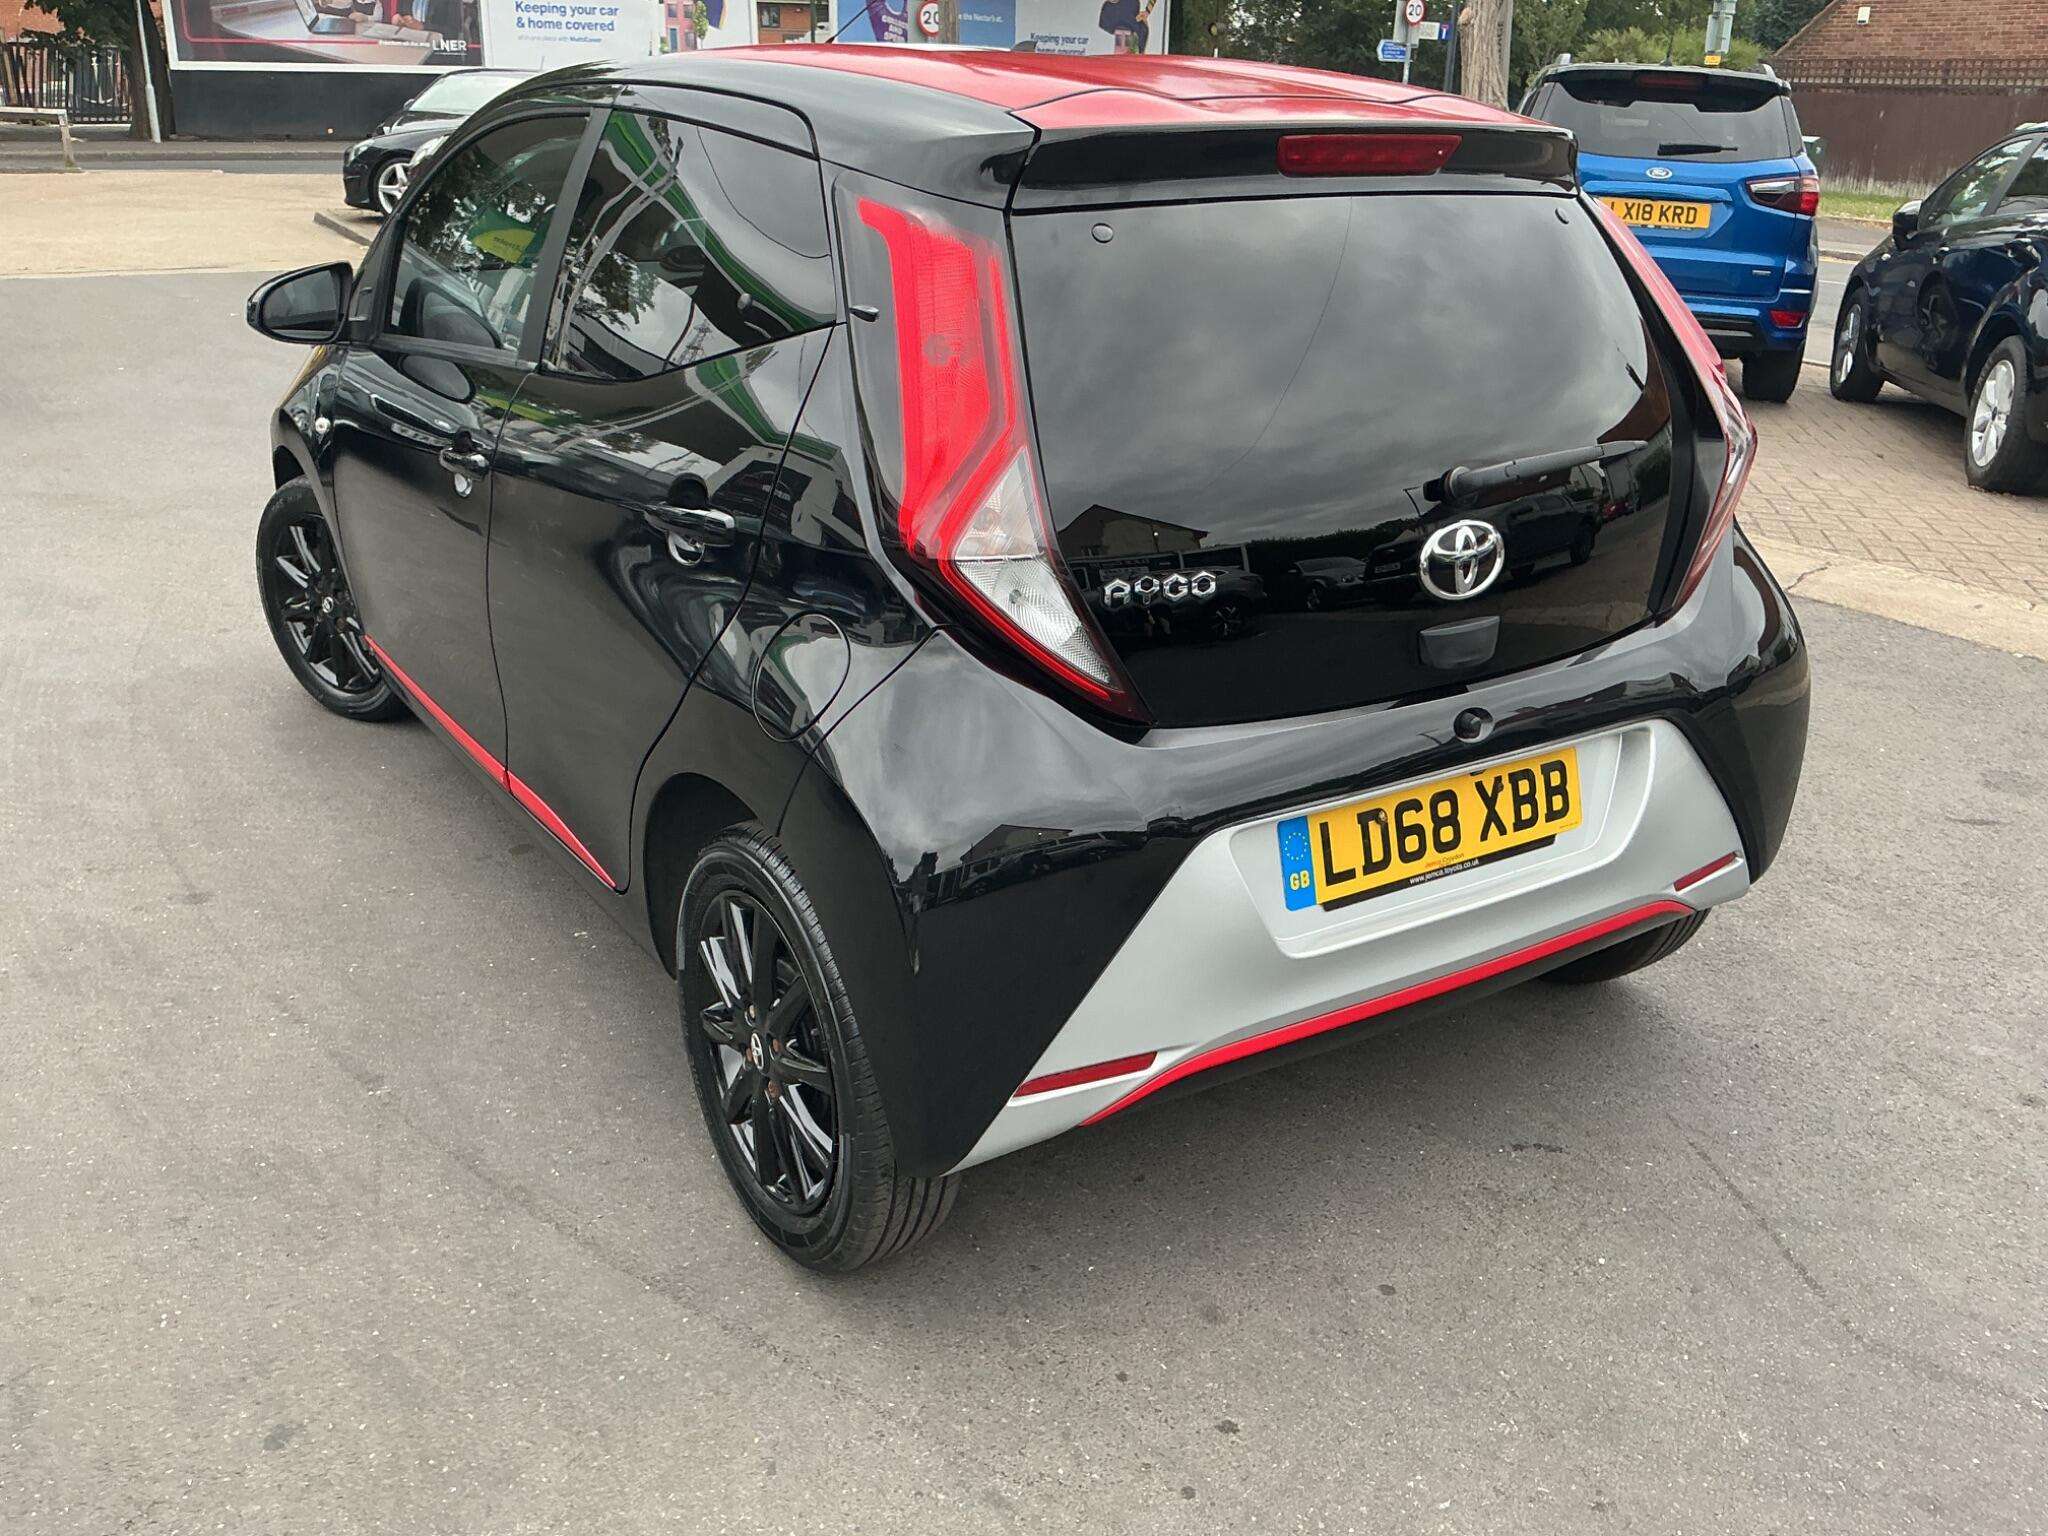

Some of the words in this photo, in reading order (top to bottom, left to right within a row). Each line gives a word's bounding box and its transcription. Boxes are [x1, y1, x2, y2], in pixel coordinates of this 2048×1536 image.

[515, 1, 567, 17] Keeping
[570, 6, 598, 17] your
[600, 8, 619, 16] car
[1408, 4, 1421, 16] 20
[516, 16, 525, 28] &
[528, 18, 562, 29] home
[565, 20, 615, 31] covered
[432, 38, 467, 52] LNER
[1031, 32, 1060, 46] Keeping
[1061, 36, 1077, 46] your
[1658, 204, 1698, 225] KRD
[1104, 571, 1216, 605] AYGO
[1319, 789, 1461, 887] LD68
[1474, 759, 1570, 842] XBB
[1289, 869, 1310, 891] GB
